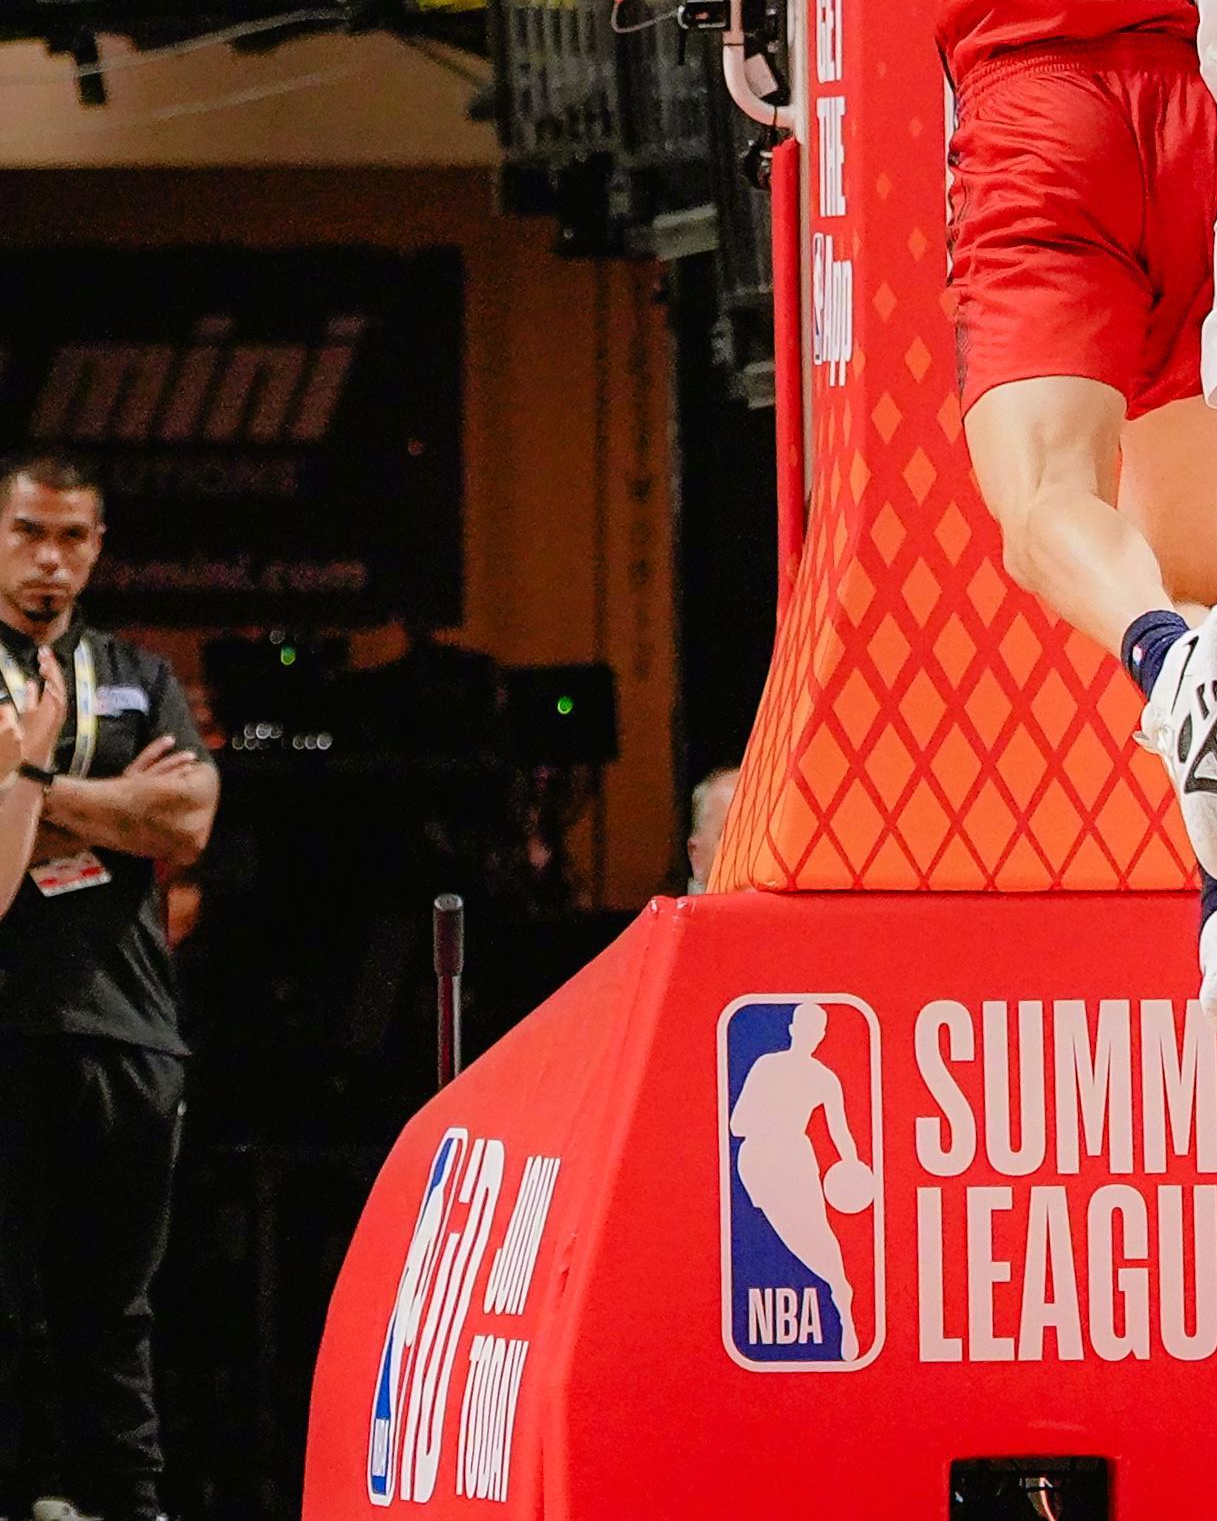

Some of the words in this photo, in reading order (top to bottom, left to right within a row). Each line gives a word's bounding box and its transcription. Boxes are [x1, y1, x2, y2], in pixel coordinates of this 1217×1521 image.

[816, 96, 846, 216] THE
[823, 235, 852, 387] App
[484, 1155, 561, 1315] JOIN
[748, 1287, 823, 1345] NBA
[456, 1334, 529, 1503] TODAY
